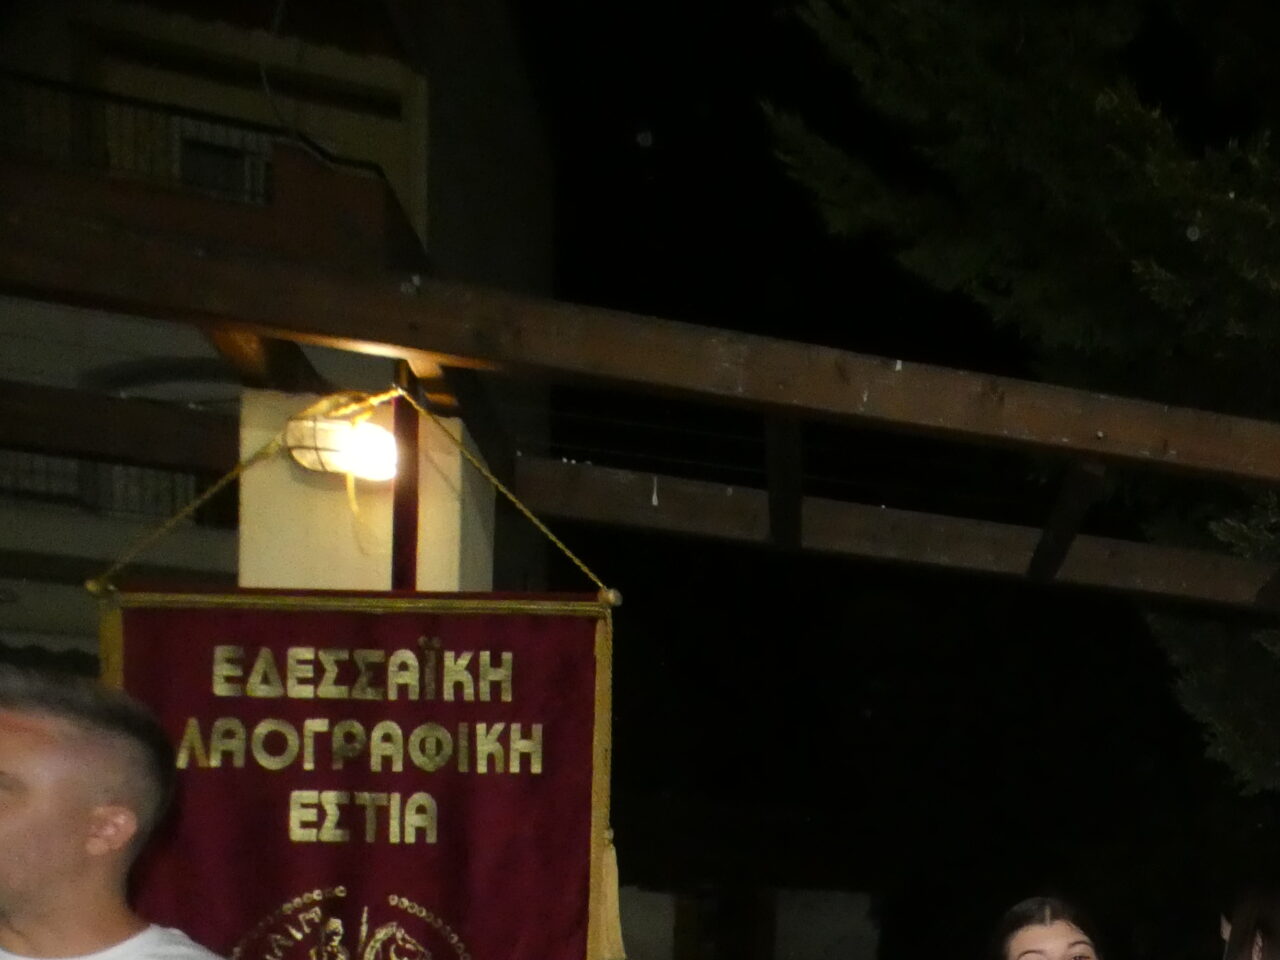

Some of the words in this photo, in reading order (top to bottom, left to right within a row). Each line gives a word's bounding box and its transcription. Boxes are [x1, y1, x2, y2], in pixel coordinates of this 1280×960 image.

[212, 636, 512, 702] ΕΔΕΣΣΑΪΚΗ
[176, 717, 542, 774] ΛΑΟΓΡΑΦΙΚΗ
[289, 789, 438, 844] ΕΣΤΙΑ
